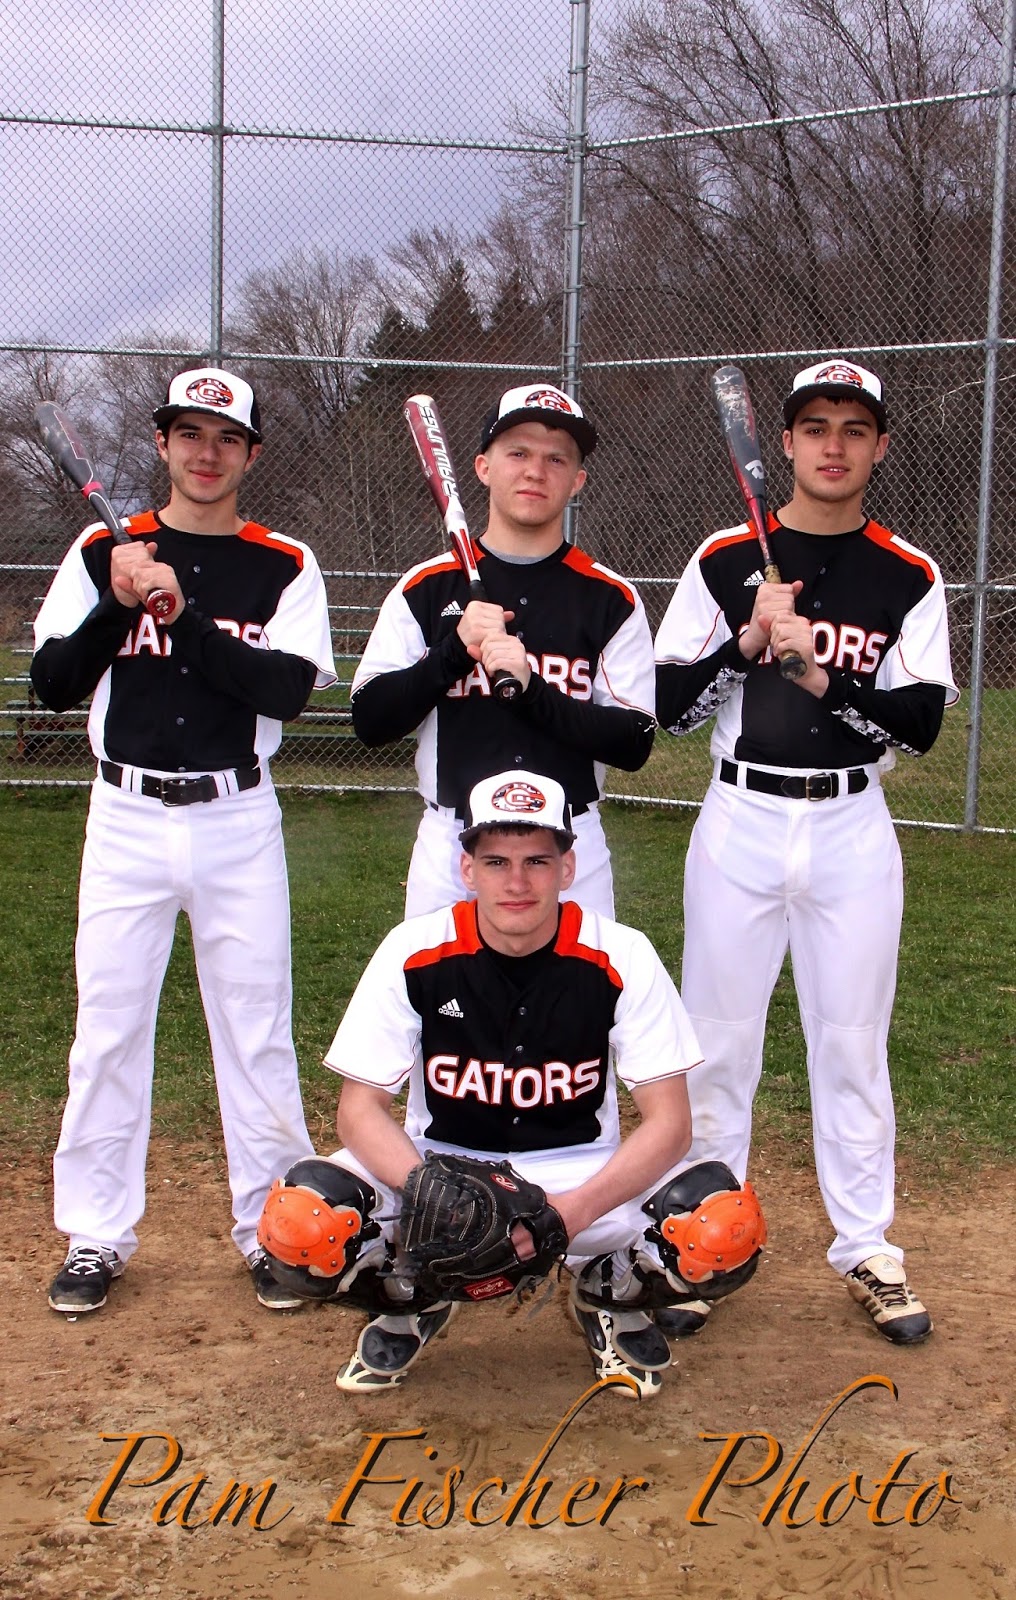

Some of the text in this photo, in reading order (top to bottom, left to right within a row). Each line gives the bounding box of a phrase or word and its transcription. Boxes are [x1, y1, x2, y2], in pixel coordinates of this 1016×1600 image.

[418, 405, 460, 498] RAWLINGS
[738, 620, 888, 674] ORS
[438, 1007, 464, 1018] adidas
[426, 1055, 601, 1107] GATORS
